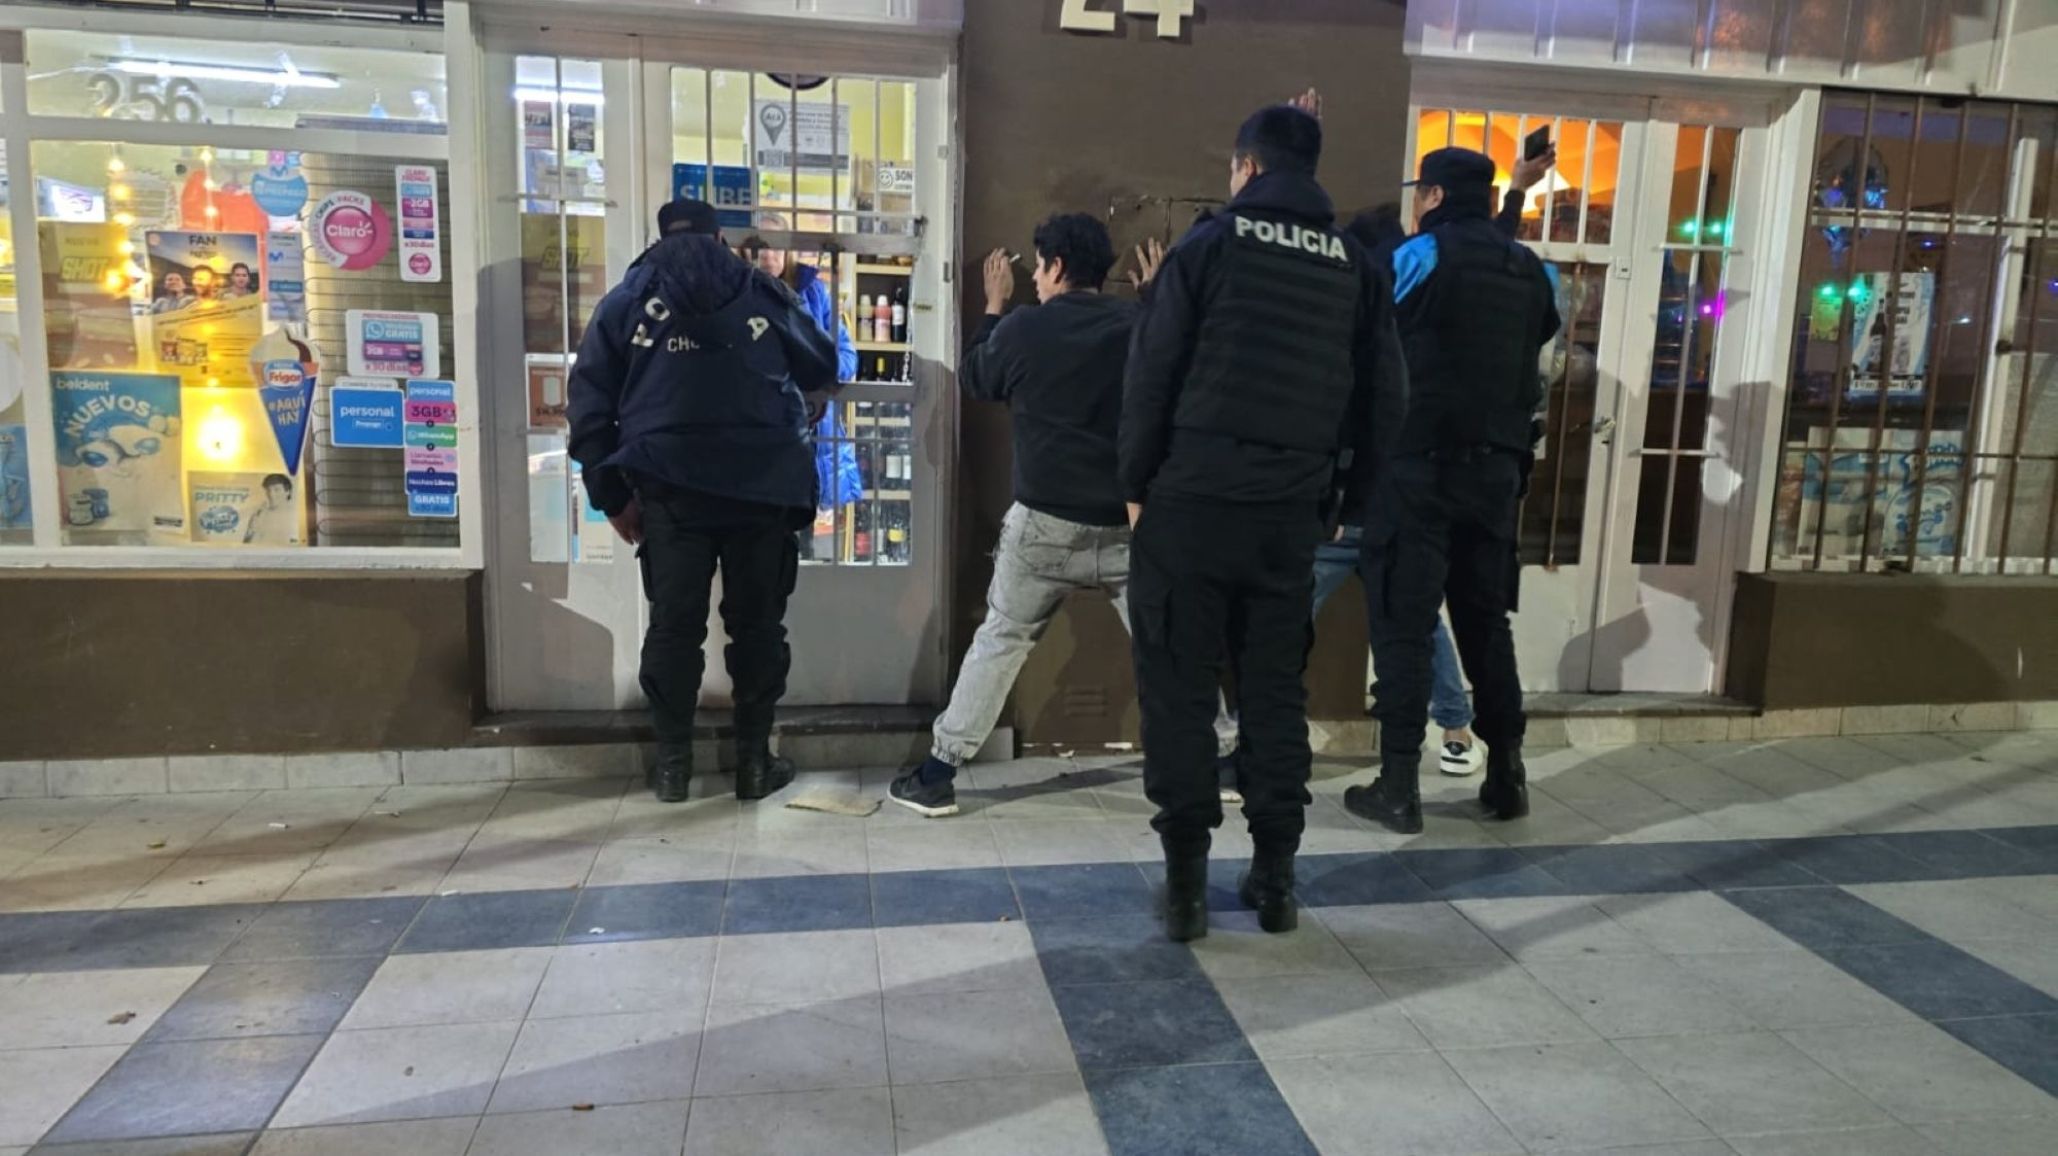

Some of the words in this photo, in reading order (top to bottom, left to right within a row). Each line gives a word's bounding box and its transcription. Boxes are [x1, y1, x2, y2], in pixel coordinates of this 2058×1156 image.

[85, 72, 201, 121] 256
[326, 224, 366, 238] Claro
[189, 235, 216, 245] FAN
[1235, 215, 1348, 262] POLICIA
[61, 257, 110, 279] SHOT
[56, 377, 110, 391] beldent
[269, 371, 303, 384] Frigor
[409, 387, 451, 397] personal
[63, 394, 151, 438] NUEVOS
[340, 406, 395, 418] personal
[194, 491, 250, 503] PRITTY
[414, 494, 451, 505] GRATIS
